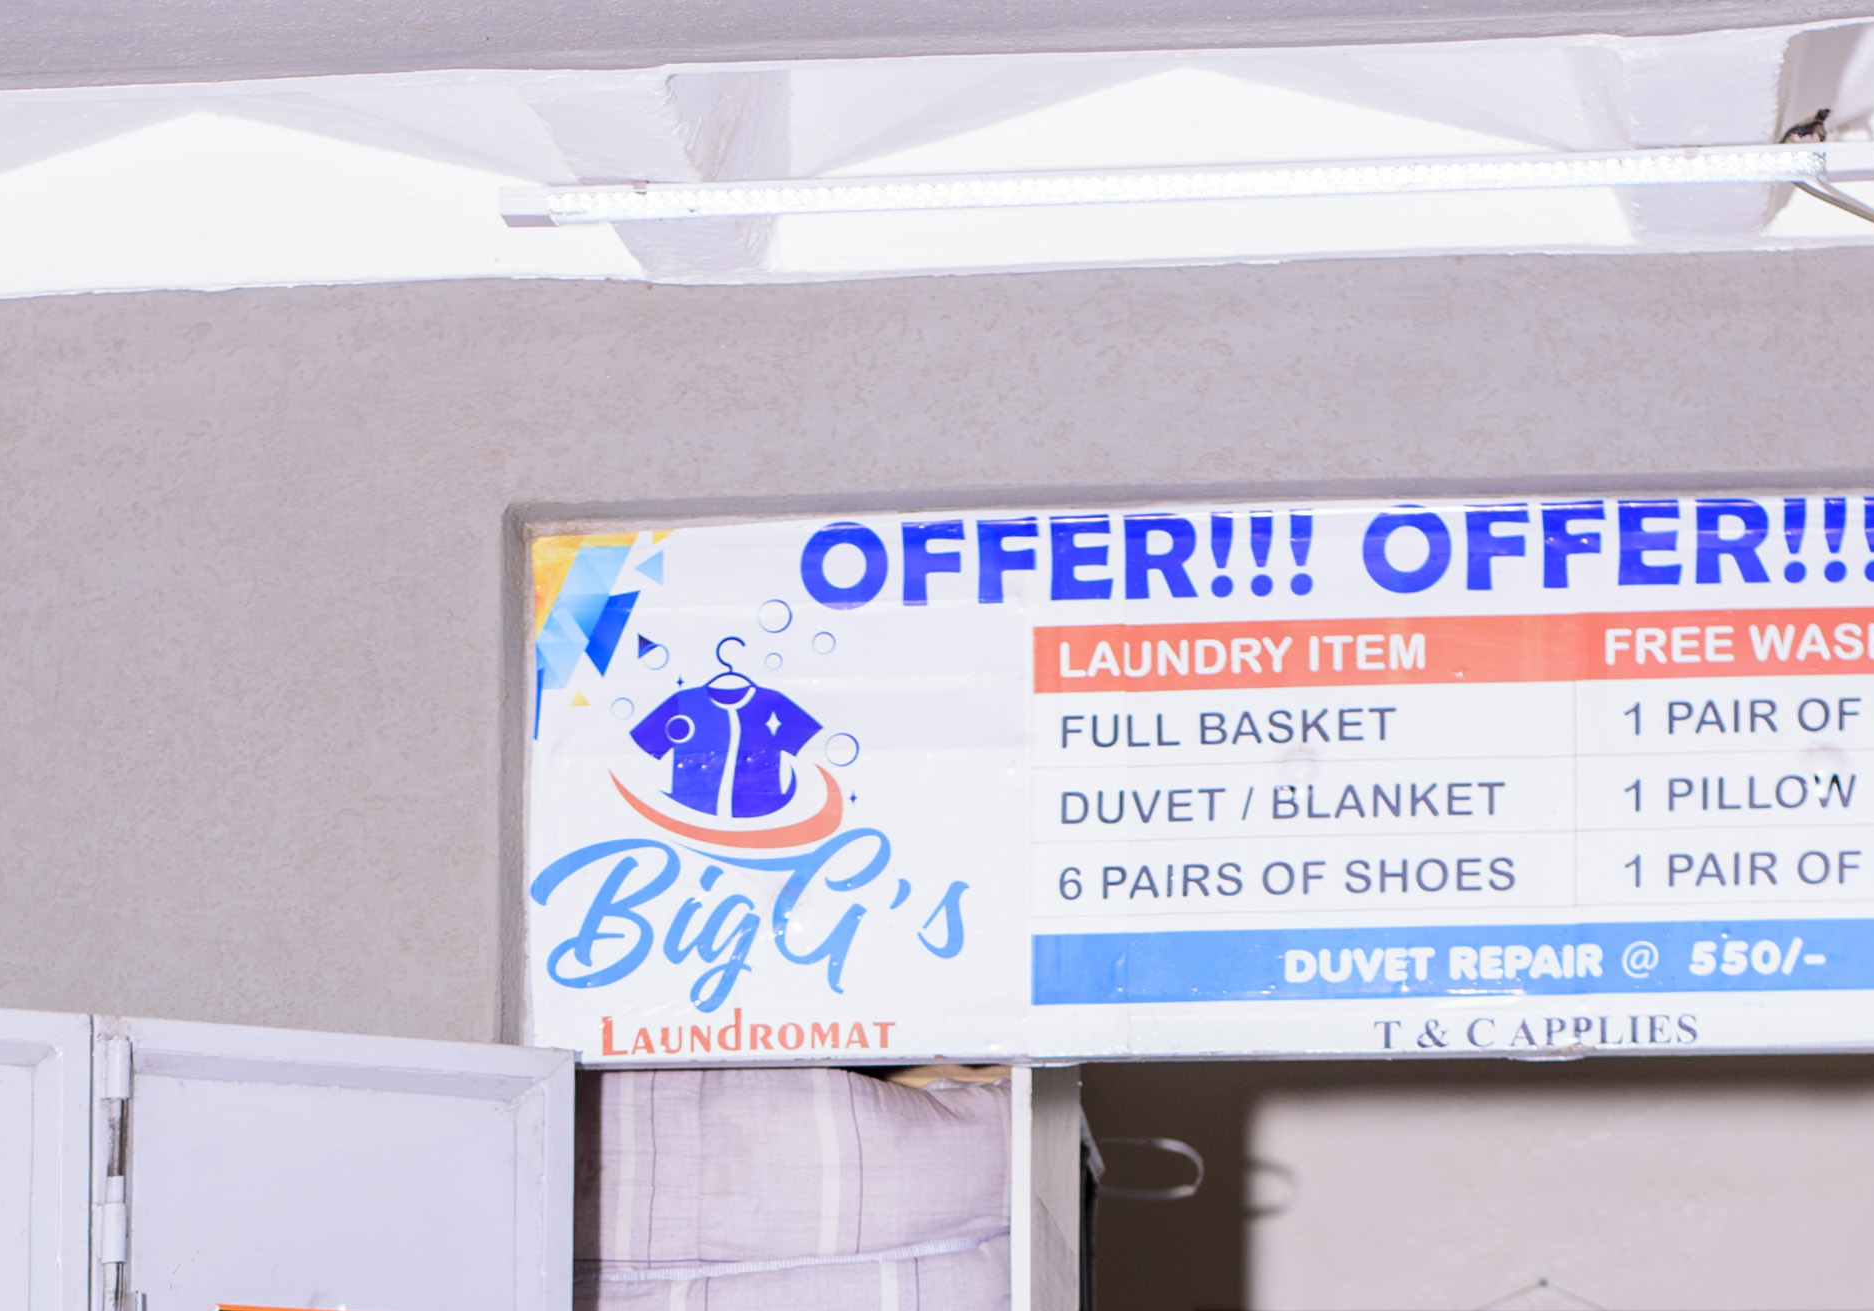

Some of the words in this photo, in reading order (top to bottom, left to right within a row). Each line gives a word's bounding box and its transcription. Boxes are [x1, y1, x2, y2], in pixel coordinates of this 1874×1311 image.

[799, 513, 1313, 610] OFFER!!!
[1058, 636, 1293, 680] LAUNDRY
[1308, 633, 1427, 673] ITEM
[1604, 627, 1735, 666] FREE
[1060, 711, 1181, 748] FULL
[1200, 707, 1397, 746] BASKET
[1624, 703, 1644, 736] 1
[1667, 699, 1779, 735] PAIR
[1797, 698, 1862, 732] OF
[1060, 786, 1227, 827] DUVET
[1240, 785, 1257, 822] /
[1274, 781, 1505, 822] BLANKET
[1624, 779, 1644, 812] 1
[1669, 774, 1857, 811] PILLOW
[1058, 865, 1083, 901] 6
[1102, 862, 1244, 900] PAIRS
[1261, 861, 1326, 895] OF
[1342, 857, 1517, 894] SHOES
[1624, 856, 1644, 889] 1
[1667, 851, 1779, 888] PAIR
[1797, 850, 1862, 885] OF
[1284, 947, 1434, 986] DUVET
[1449, 941, 1602, 980] REPAIR
[1621, 940, 1661, 979] @
[1689, 936, 1826, 978] 550/-
[1373, 1020, 1401, 1051] T
[1417, 1019, 1448, 1049] &
[1466, 1017, 1496, 1049] C
[1510, 1012, 1698, 1048] APPLIES
